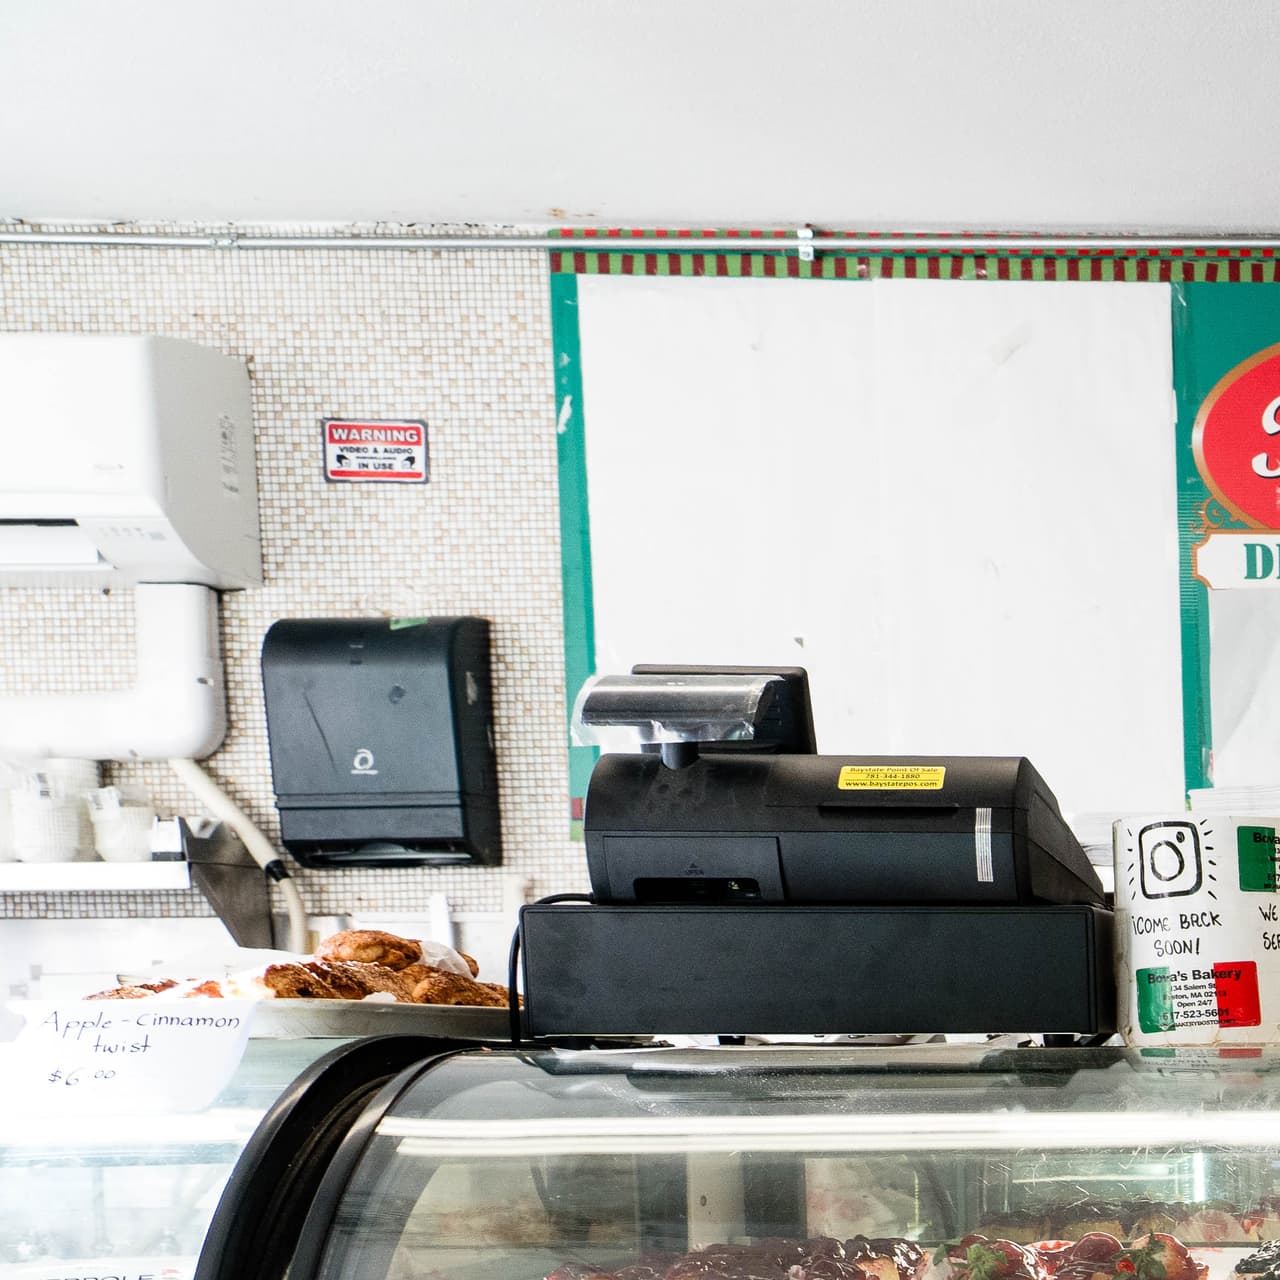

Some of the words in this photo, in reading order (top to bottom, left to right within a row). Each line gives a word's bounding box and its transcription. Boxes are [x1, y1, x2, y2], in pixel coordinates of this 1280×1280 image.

[332, 429, 418, 442] WARNING
[1258, 903, 1279, 922] WE
[1154, 937, 1200, 957] SOON!
[1147, 970, 1188, 984] Bova's
[1192, 968, 1242, 980] Bakery
[1184, 983, 1206, 991] Salem
[1190, 991, 1203, 999] MA
[42, 1011, 112, 1040] Apple
[136, 1012, 240, 1029] Cinnamon
[92, 1034, 151, 1053] twist
